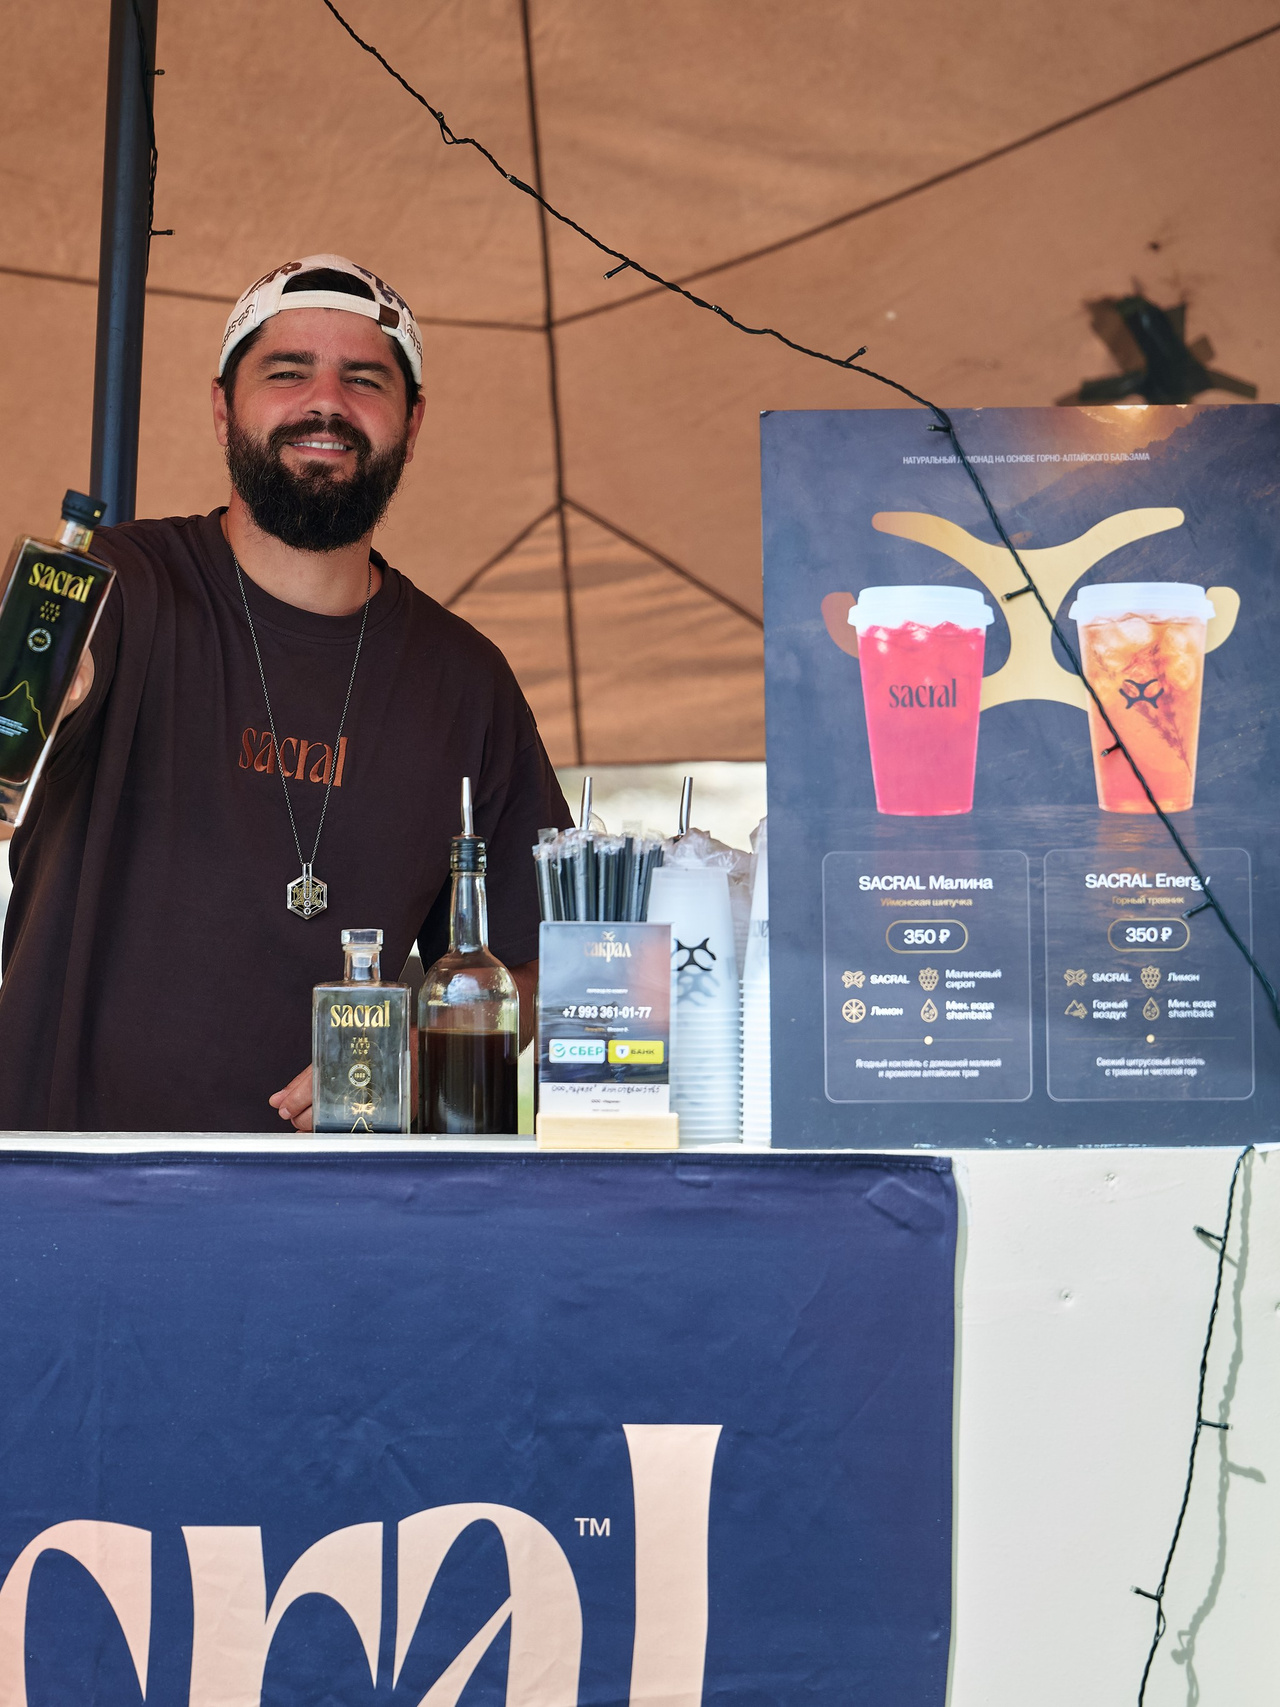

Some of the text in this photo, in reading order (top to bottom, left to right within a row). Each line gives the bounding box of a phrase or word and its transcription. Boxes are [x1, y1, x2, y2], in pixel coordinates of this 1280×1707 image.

[902, 455, 956, 465] НАТУРАЛЬНЫЙ
[995, 455, 1005, 463] НА
[1006, 454, 1035, 463] ОСНОВЕ
[1036, 453, 1109, 462] ГОРНО-АЛТАЙСКОГО
[1110, 453, 1150, 461] БАЛЬЗАМА
[28, 562, 95, 604] sacral
[888, 678, 957, 709] sacral
[238, 727, 349, 787] sacral
[858, 875, 994, 891] SACRAL Малина
[1085, 873, 1152, 888] SACRAL
[1111, 894, 1185, 906] Горный травник
[903, 928, 937, 945] 350
[1125, 926, 1158, 943] 350
[583, 941, 632, 963] сакрал
[870, 974, 910, 985] SACRAL
[945, 969, 1002, 979] Малиновый
[1092, 972, 1132, 983] SACRAL
[1167, 972, 1200, 982] Лимон
[945, 981, 976, 990] сироп
[945, 1001, 995, 1010] Мин. вода
[1092, 1000, 1128, 1010] Горный
[1167, 999, 1217, 1009] Мин. вода
[330, 1000, 390, 1028] sacral
[562, 1006, 652, 1019] +7 993 361-01-77
[870, 1006, 904, 1016] Лимон
[1092, 1011, 1127, 1020] воздух
[569, 1046, 603, 1056] СБЕР
